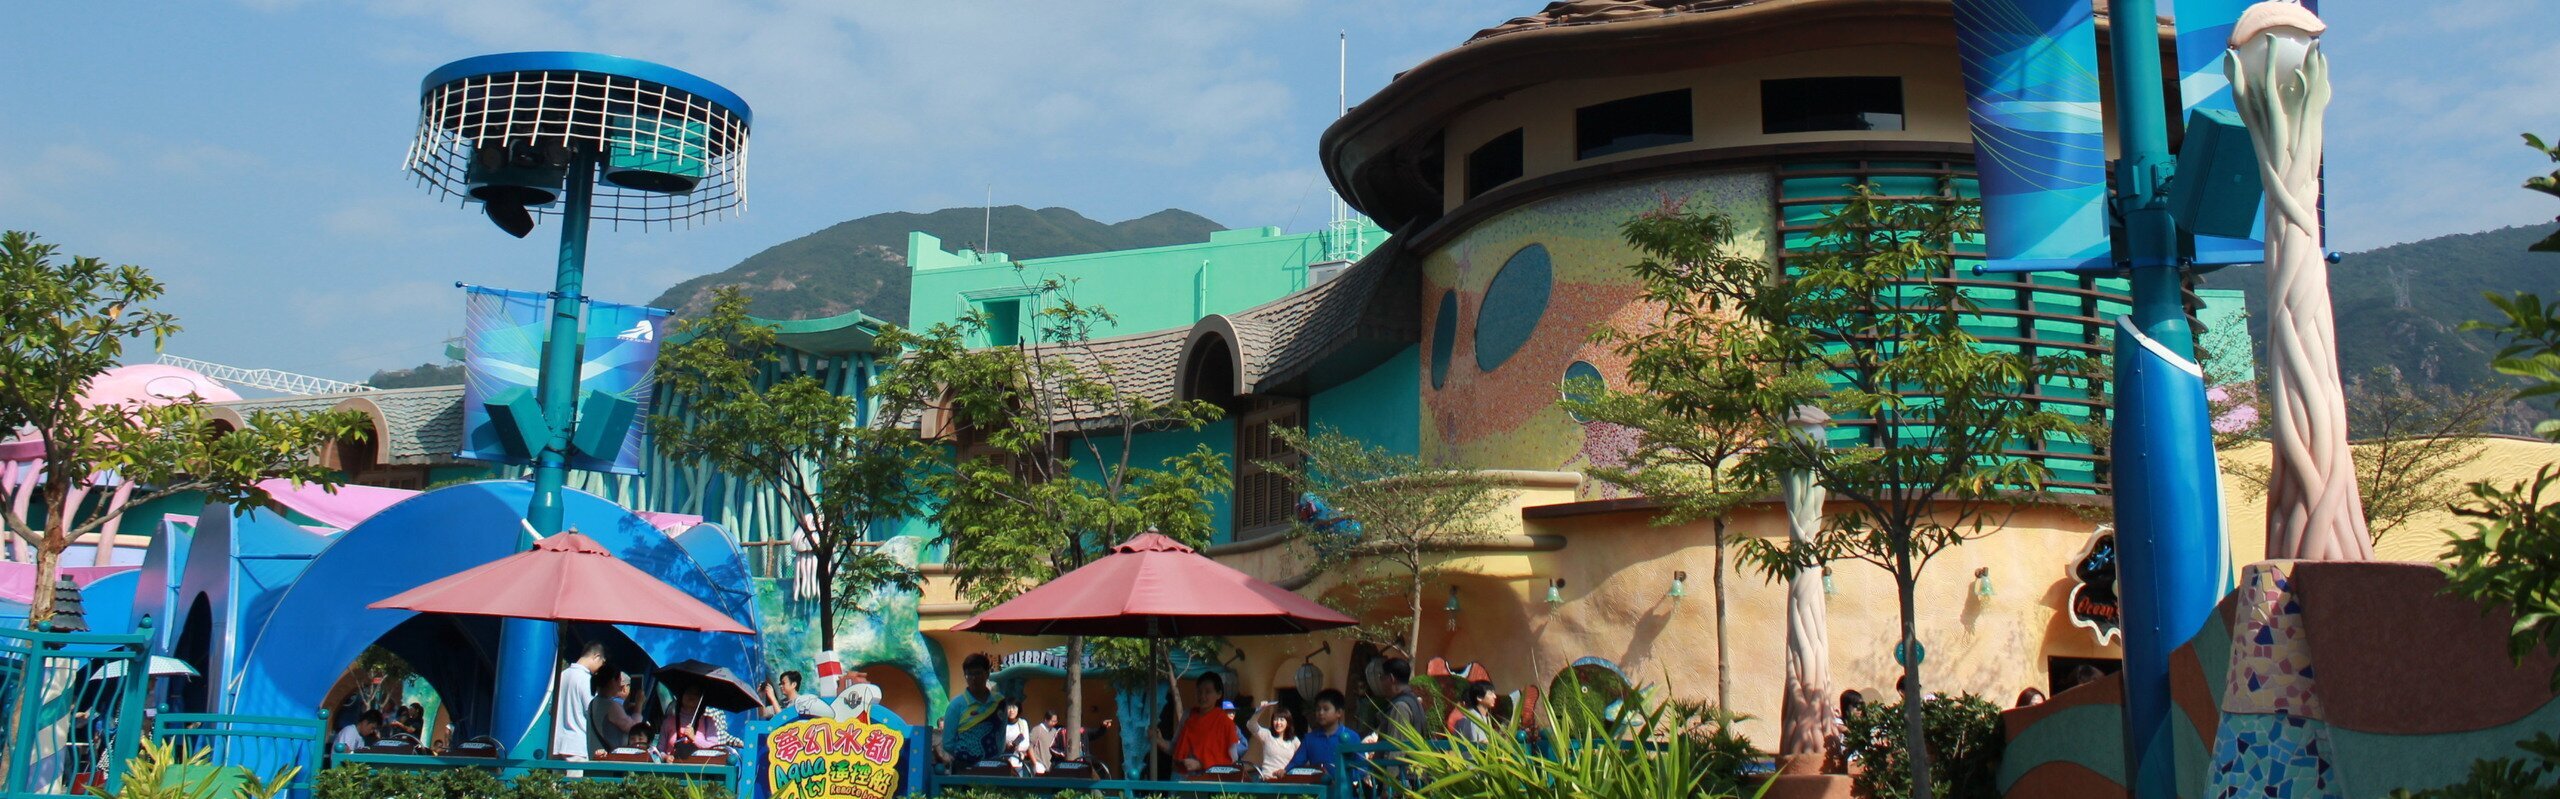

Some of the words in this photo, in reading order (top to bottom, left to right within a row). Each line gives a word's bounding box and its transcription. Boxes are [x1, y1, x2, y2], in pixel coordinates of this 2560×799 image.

[1002, 650, 1071, 671] CELEBRITIE
[774, 723, 896, 765] 夢幻水都
[775, 756, 827, 790] Aqua
[787, 776, 827, 799] ity
[829, 783, 863, 798] Remote
